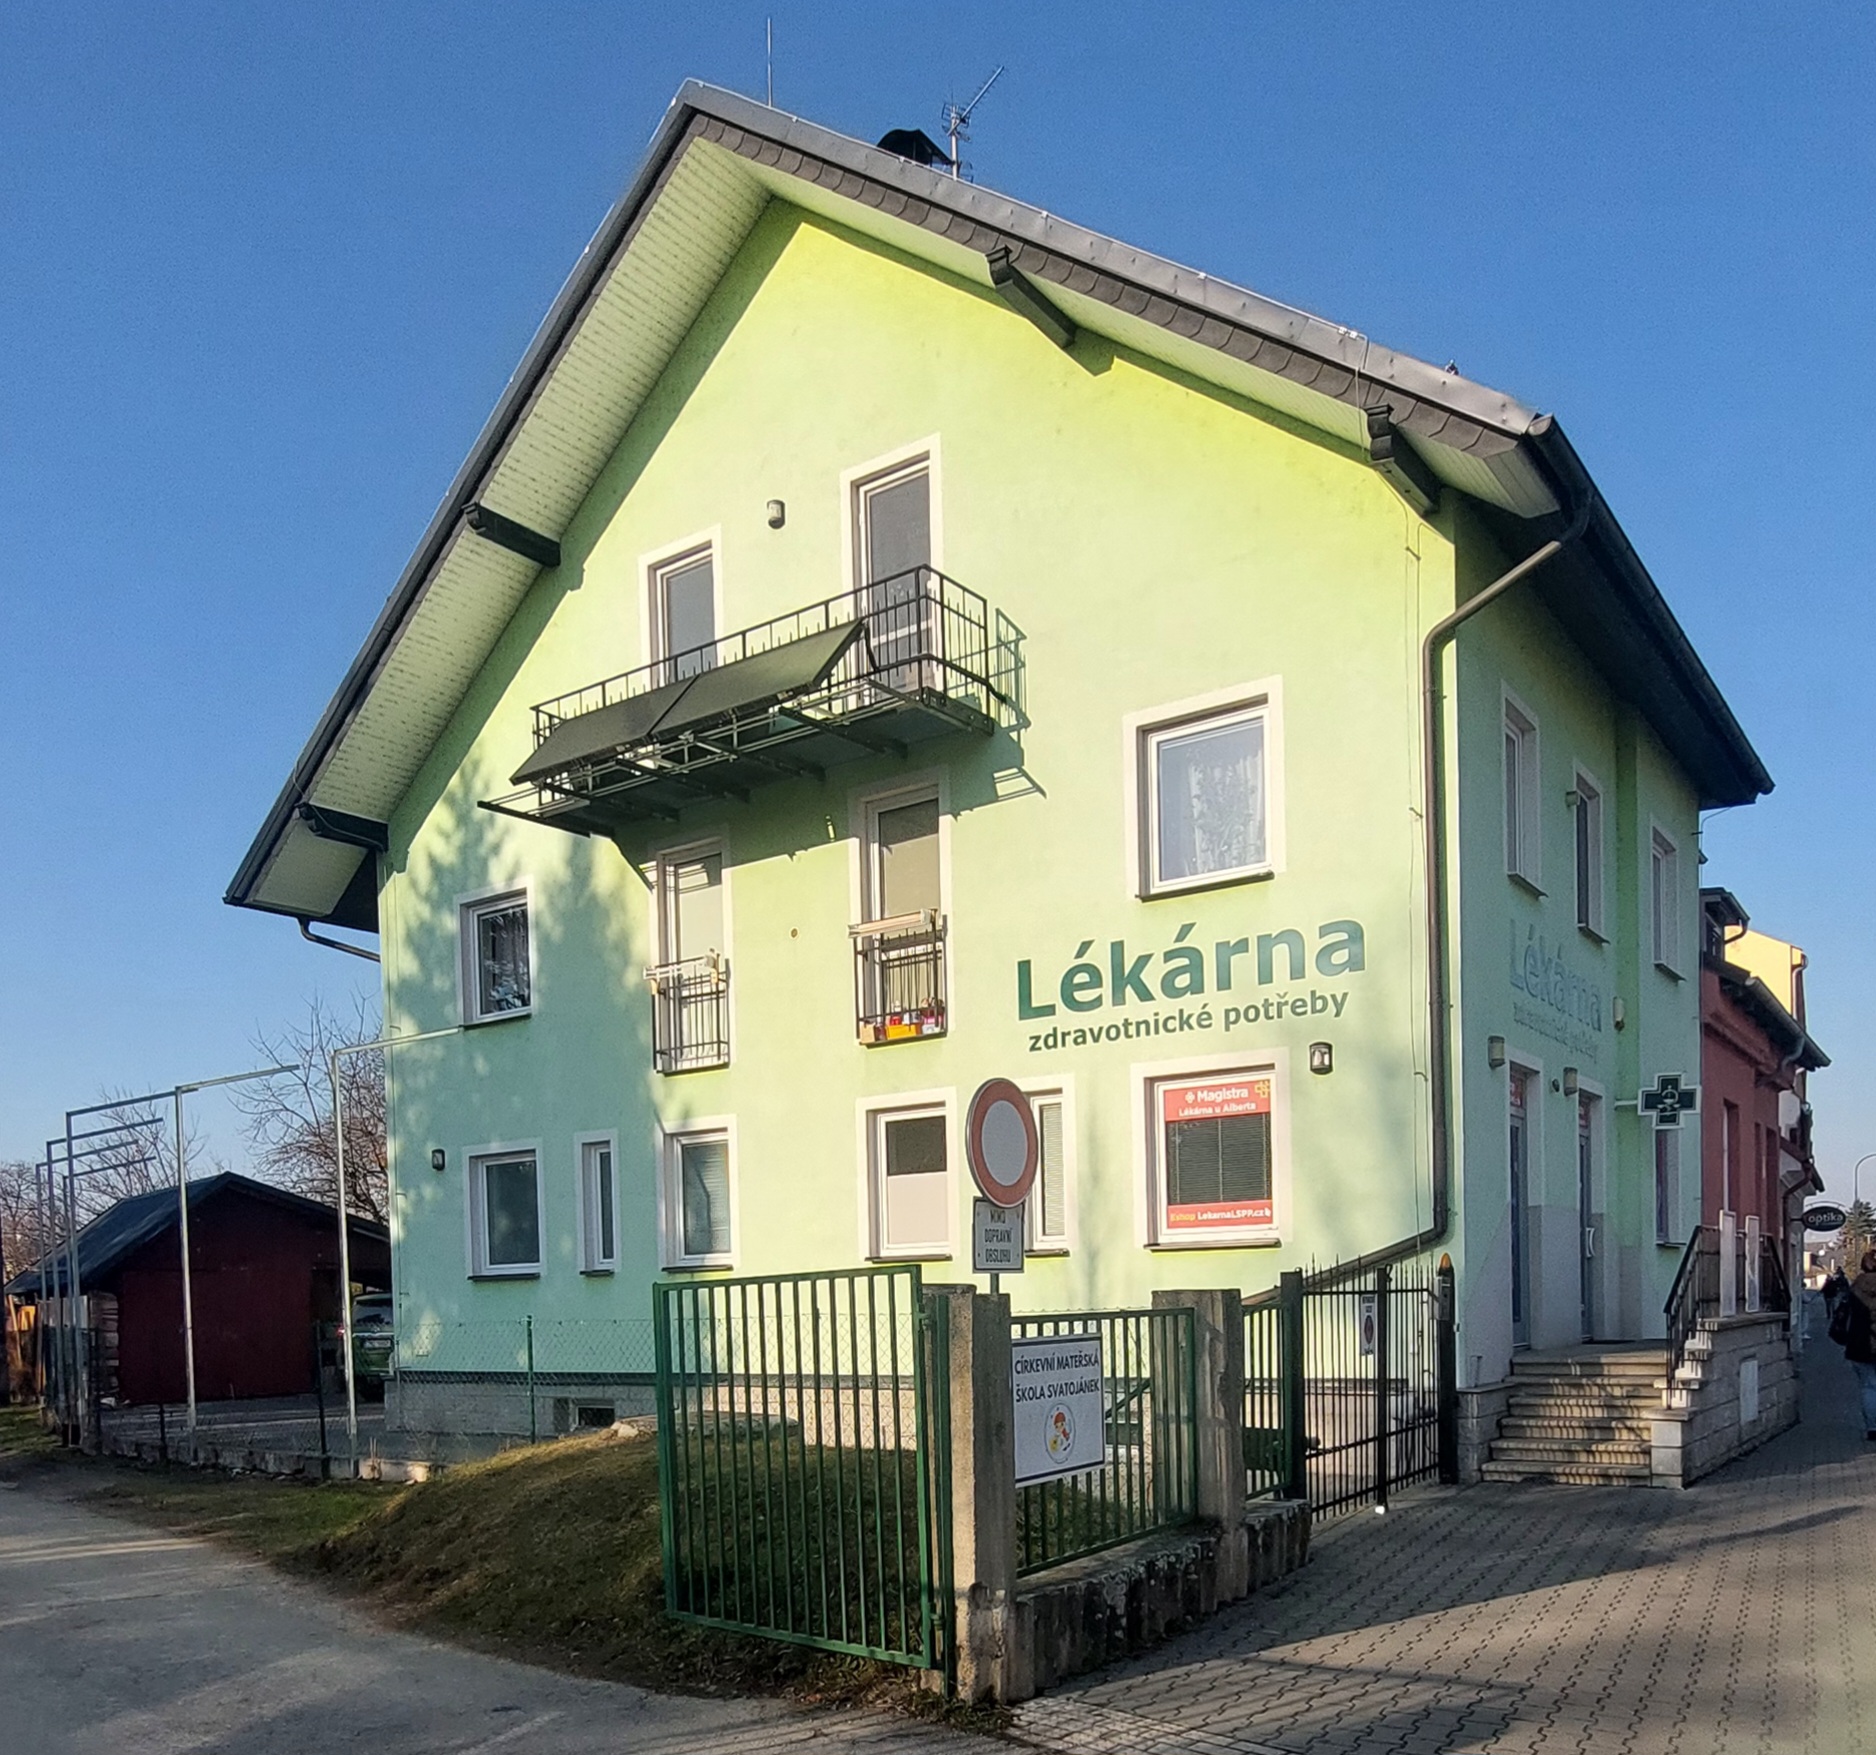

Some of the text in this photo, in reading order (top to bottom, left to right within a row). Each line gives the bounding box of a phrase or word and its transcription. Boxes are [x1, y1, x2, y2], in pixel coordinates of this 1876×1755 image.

[1017, 918, 1366, 1021] Lékárna
[1509, 918, 1602, 1033] Lékárna
[1028, 990, 1349, 1052] zdravotnické potřeby
[1197, 1088, 1249, 1103] Magistra
[1222, 1102, 1257, 1113] Alberta
[1808, 1212, 1844, 1226] optika
[1014, 1349, 1099, 1375] CÍRKEVNÍ MATEŘSKÁ
[1015, 1376, 1100, 1403] ŠKOLA SVATOJÁNEK
